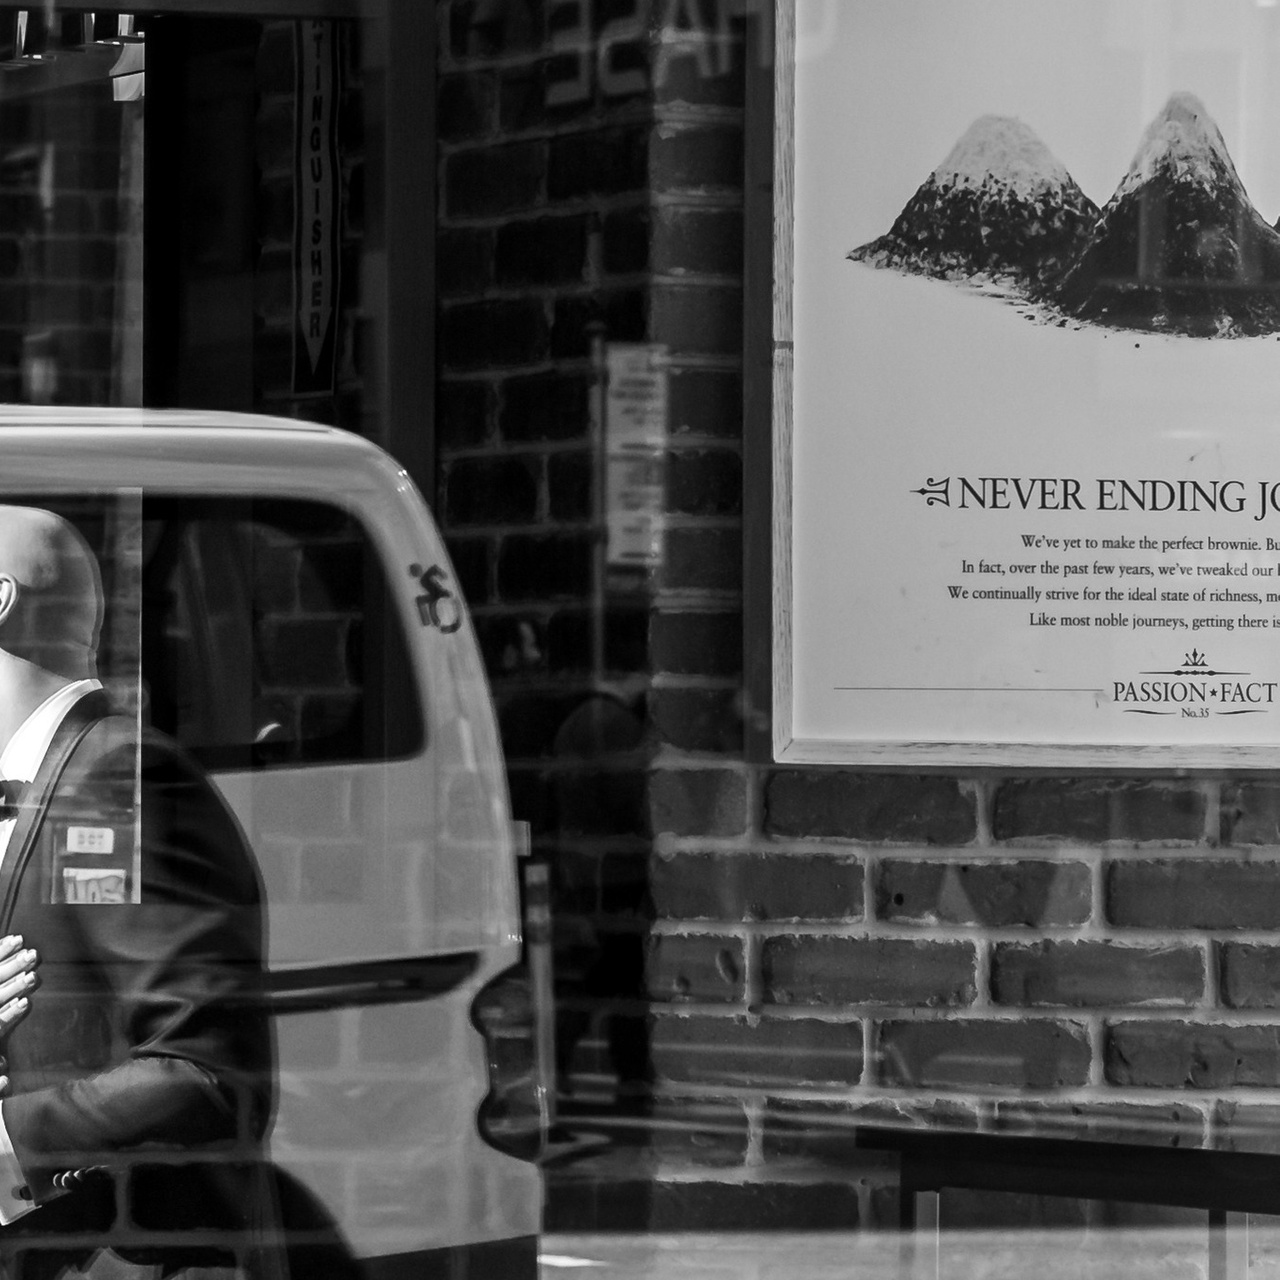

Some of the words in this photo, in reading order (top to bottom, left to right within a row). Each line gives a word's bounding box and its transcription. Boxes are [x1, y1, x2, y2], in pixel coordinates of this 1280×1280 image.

[308, 20, 325, 339] TINGUISHER
[958, 478, 1086, 510] NEVER
[1096, 480, 1246, 512] ENDING
[1063, 539, 1081, 551] yet
[1085, 539, 1098, 548] to
[1102, 535, 1135, 549] make
[1139, 536, 1158, 549] the
[1162, 536, 1203, 553] perfect
[1208, 536, 1261, 550] brownie.
[962, 560, 974, 573] In
[979, 559, 1005, 575] fact,
[1009, 565, 1036, 573] over
[1041, 561, 1059, 574] the
[1064, 565, 1088, 577] past
[1093, 561, 1115, 574] few
[1119, 566, 1154, 578] years,
[1197, 563, 1248, 576] tweaked
[1252, 568, 1273, 576] our
[947, 586, 968, 599] We
[972, 586, 1041, 603] continually
[1046, 588, 1079, 600] strive
[1083, 587, 1101, 600] for
[1105, 587, 1124, 600] the
[1128, 587, 1156, 601] ideal
[1161, 592, 1189, 601] state
[1193, 588, 1206, 601] of
[1210, 588, 1262, 604] richness,
[1030, 612, 1056, 625] Like
[1061, 617, 1090, 626] most
[1095, 613, 1128, 626] noble
[1133, 614, 1188, 630] journeys,
[1192, 615, 1234, 631] getting
[1238, 614, 1268, 627] there
[1114, 682, 1206, 702] PASSION
[1220, 683, 1277, 702] FACT
